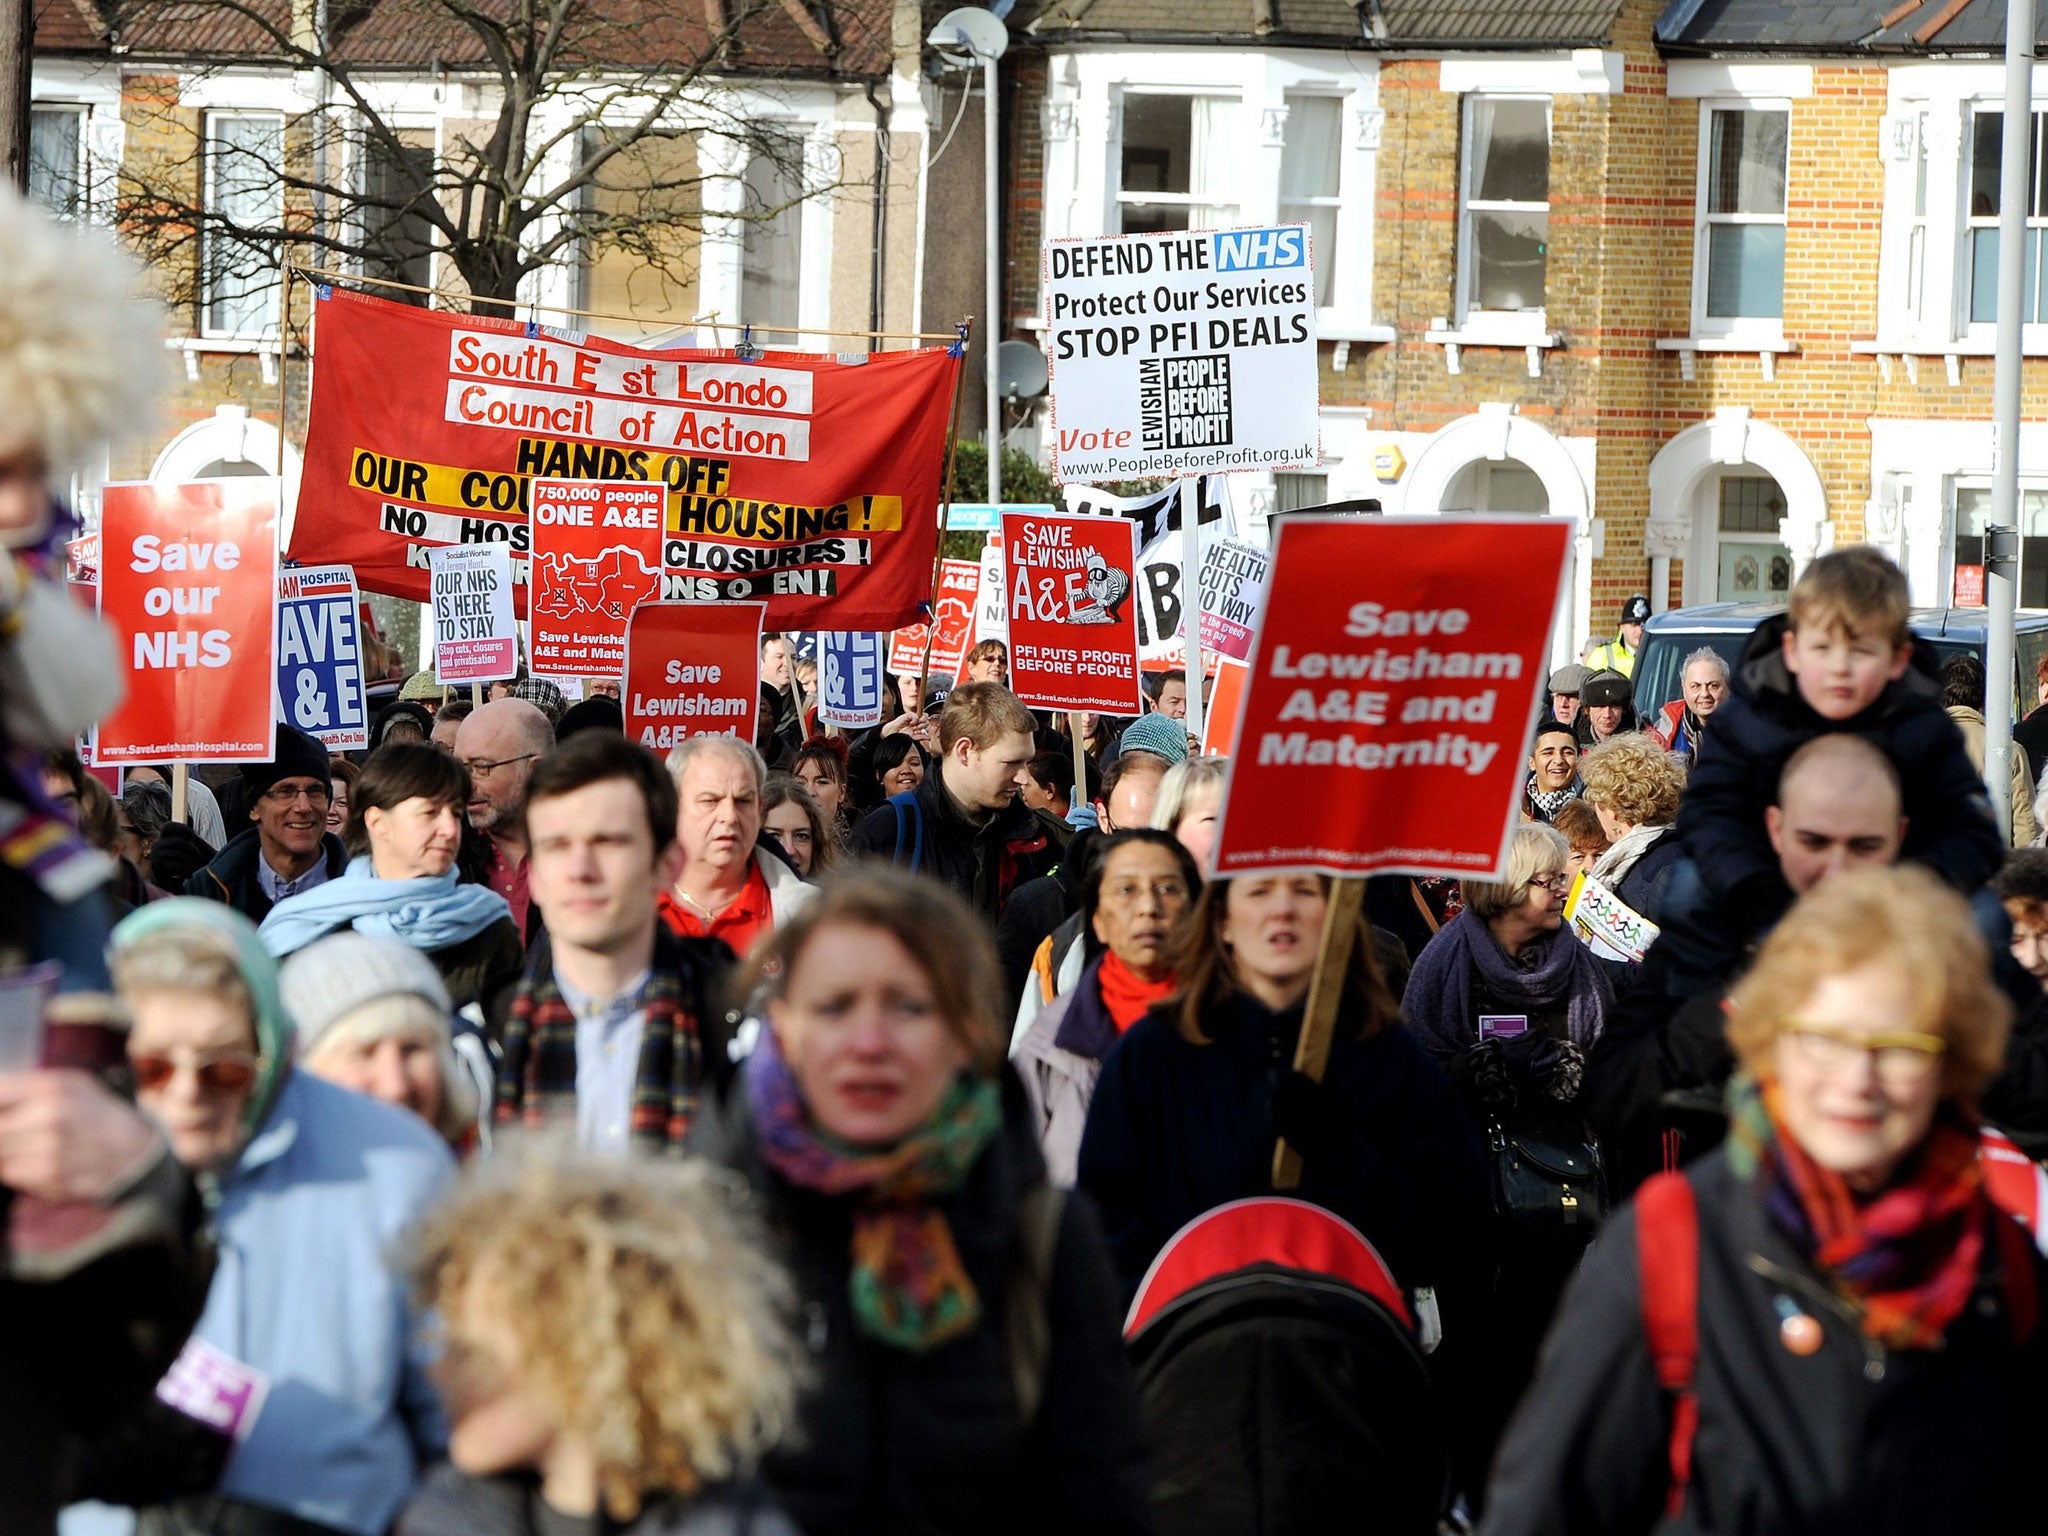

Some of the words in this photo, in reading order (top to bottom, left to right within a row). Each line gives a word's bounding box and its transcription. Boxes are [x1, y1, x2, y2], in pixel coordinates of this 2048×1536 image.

[1052, 242, 1153, 279] DEFEND
[1159, 239, 1209, 271] THE
[1217, 230, 1301, 271] NHS
[1054, 290, 1146, 319] Protect
[1153, 286, 1199, 312] Our
[1205, 278, 1306, 309] Services
[1057, 326, 1139, 360] STOP
[1150, 322, 1198, 353] PFI
[1209, 313, 1309, 349] DEALS
[454, 336, 559, 383] South
[572, 353, 602, 392] E
[622, 364, 657, 397] st
[677, 365, 788, 409] Londo
[1167, 357, 1229, 388] PEOPLE
[1139, 358, 1164, 451] LEWISHAM
[1168, 386, 1229, 416] BEFORE
[459, 385, 594, 436] Council
[620, 410, 655, 442] of
[673, 411, 786, 456] Action
[1169, 414, 1230, 447] PROFIT
[1060, 428, 1132, 452] Vote
[516, 438, 650, 481] HANDS
[662, 455, 729, 495] OFF
[1062, 444, 1314, 476] www.PeopleBeforeProfit.org.uk
[354, 451, 428, 501] OUR
[679, 495, 849, 541] HOUSING
[537, 486, 601, 502] 750,000
[605, 490, 658, 506] people
[536, 503, 594, 526] ONE
[601, 506, 659, 529] A&E
[384, 504, 427, 537] NO
[460, 517, 529, 552] HOS
[665, 538, 847, 573] CLOSURES
[1022, 522, 1073, 547] SAVE
[130, 535, 241, 574] Save
[1012, 540, 1096, 571] LEWISHAM
[1204, 543, 1268, 584] HEALTH
[83, 570, 97, 582] 75
[300, 572, 351, 586] HOSPITAL
[435, 572, 462, 595] OUR
[467, 569, 498, 592] NHS
[942, 575, 977, 591] A&E
[1199, 565, 1244, 598] CUTS
[144, 586, 220, 617] our
[436, 596, 450, 618] IS
[454, 593, 492, 617] HERE
[1011, 566, 1092, 624] A&E
[1219, 595, 1256, 626] WAY
[280, 601, 356, 667] AVE
[438, 619, 455, 641] TO
[460, 616, 494, 641] STAY
[1208, 615, 1221, 628] the
[1220, 622, 1247, 640] greedy
[1344, 601, 1470, 637] Save
[133, 629, 232, 669] NHS
[439, 643, 455, 656] Stop
[455, 643, 472, 654] cuts,
[472, 641, 504, 653] closures
[534, 646, 560, 657] A&E
[563, 648, 587, 659] and
[591, 648, 624, 660] Mate
[539, 631, 570, 644] Save
[573, 632, 625, 645] Lewisha
[440, 657, 454, 668] and
[454, 655, 497, 668] privatisation
[1015, 644, 1038, 658] PFI
[1041, 648, 1078, 662] PUTS
[1081, 650, 1133, 666] PROFIT
[1016, 658, 1073, 674] BEFORE
[1077, 662, 1134, 679] PEOPLE
[1270, 645, 1524, 682] Lewisham
[665, 659, 722, 684] Save
[294, 668, 330, 728] &
[334, 665, 361, 725] E
[633, 693, 748, 717] Lewisham
[1017, 692, 1136, 708] www.SaveLewishamHospital.com
[1278, 688, 1390, 725] A&E
[1400, 690, 1497, 724] and
[102, 742, 264, 756] www.SaveLewishamHospital.com
[639, 725, 687, 750] A&E
[1256, 732, 1499, 775] Maternity
